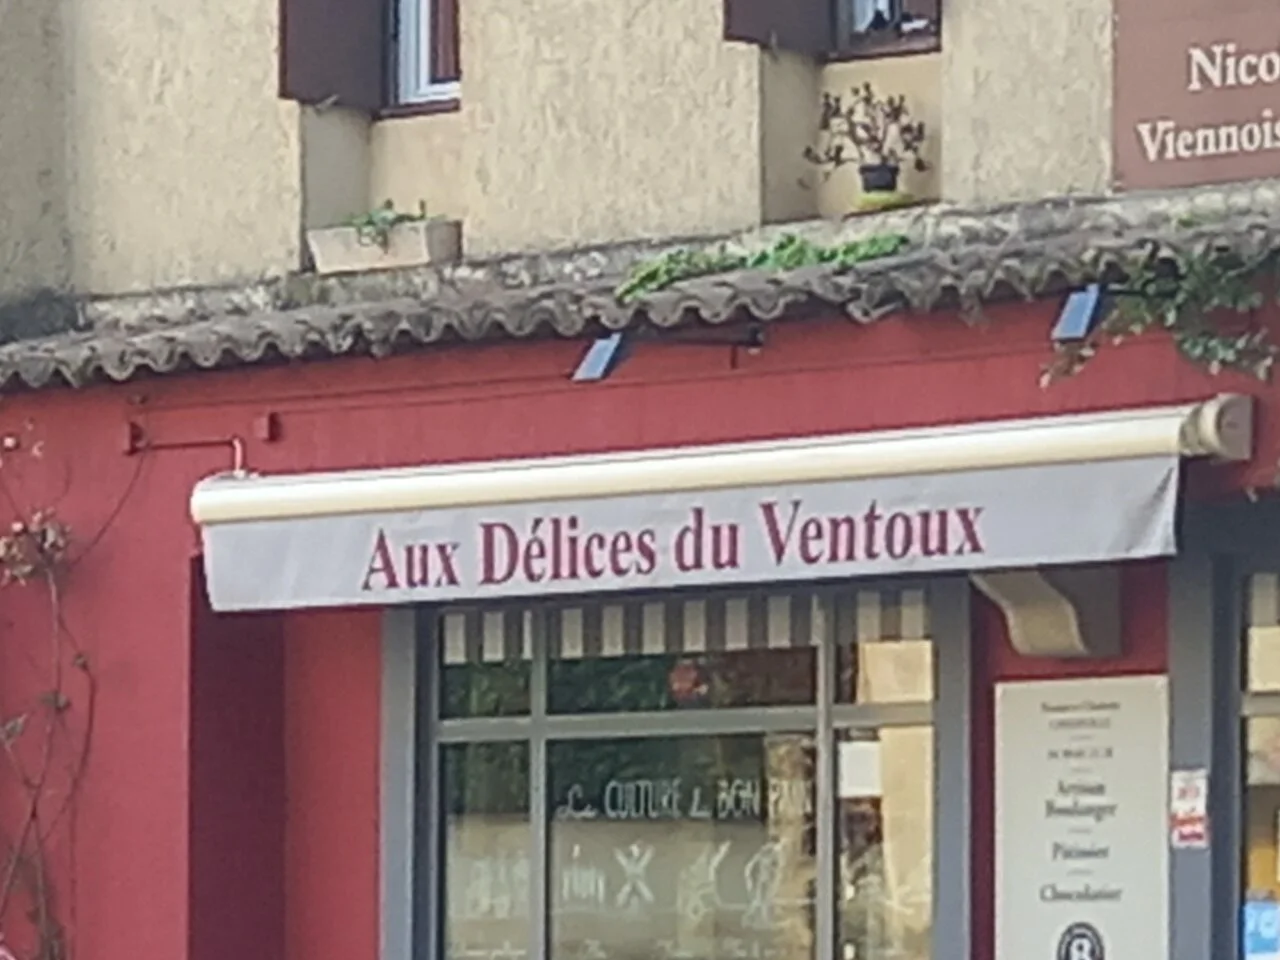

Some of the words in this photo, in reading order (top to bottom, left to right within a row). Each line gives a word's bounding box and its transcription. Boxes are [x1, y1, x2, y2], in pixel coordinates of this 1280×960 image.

[361, 527, 461, 590] Aux
[478, 512, 656, 586] Délices
[674, 507, 740, 571] du
[758, 499, 985, 567] Ventoux
